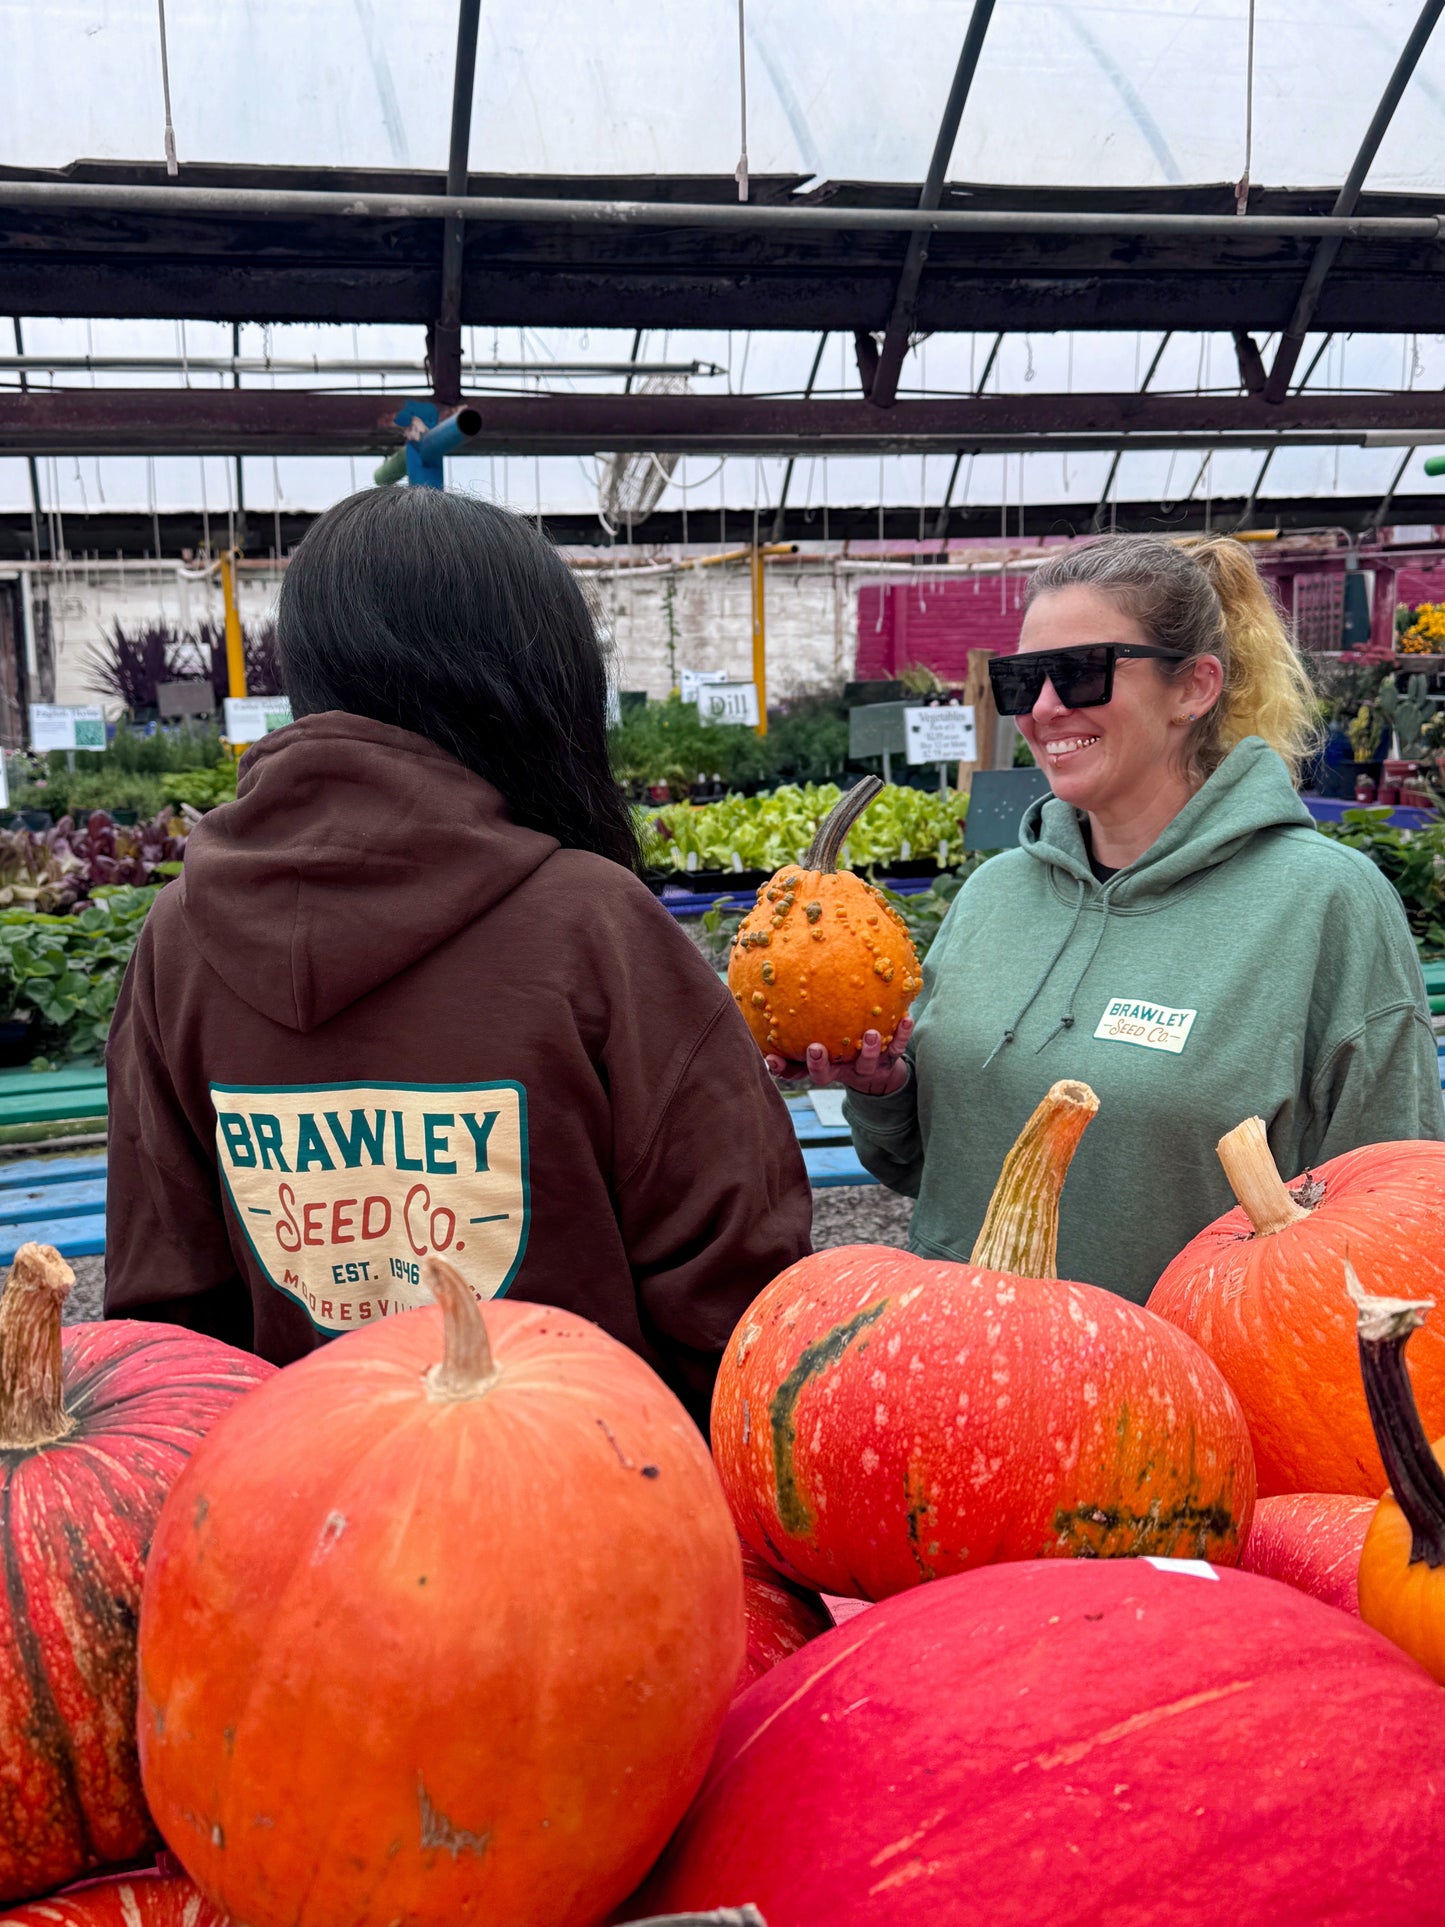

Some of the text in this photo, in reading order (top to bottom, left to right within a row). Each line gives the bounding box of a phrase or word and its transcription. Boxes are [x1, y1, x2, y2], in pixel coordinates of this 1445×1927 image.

[709, 694, 748, 716] Dill
[918, 711, 966, 723] Vegetables
[1109, 1003, 1190, 1027] BRAWLEY
[218, 1108, 501, 1175] BRAWLEY
[331, 1257, 420, 1286] EST. 1946
[283, 1268, 428, 1321] MOORESVI
